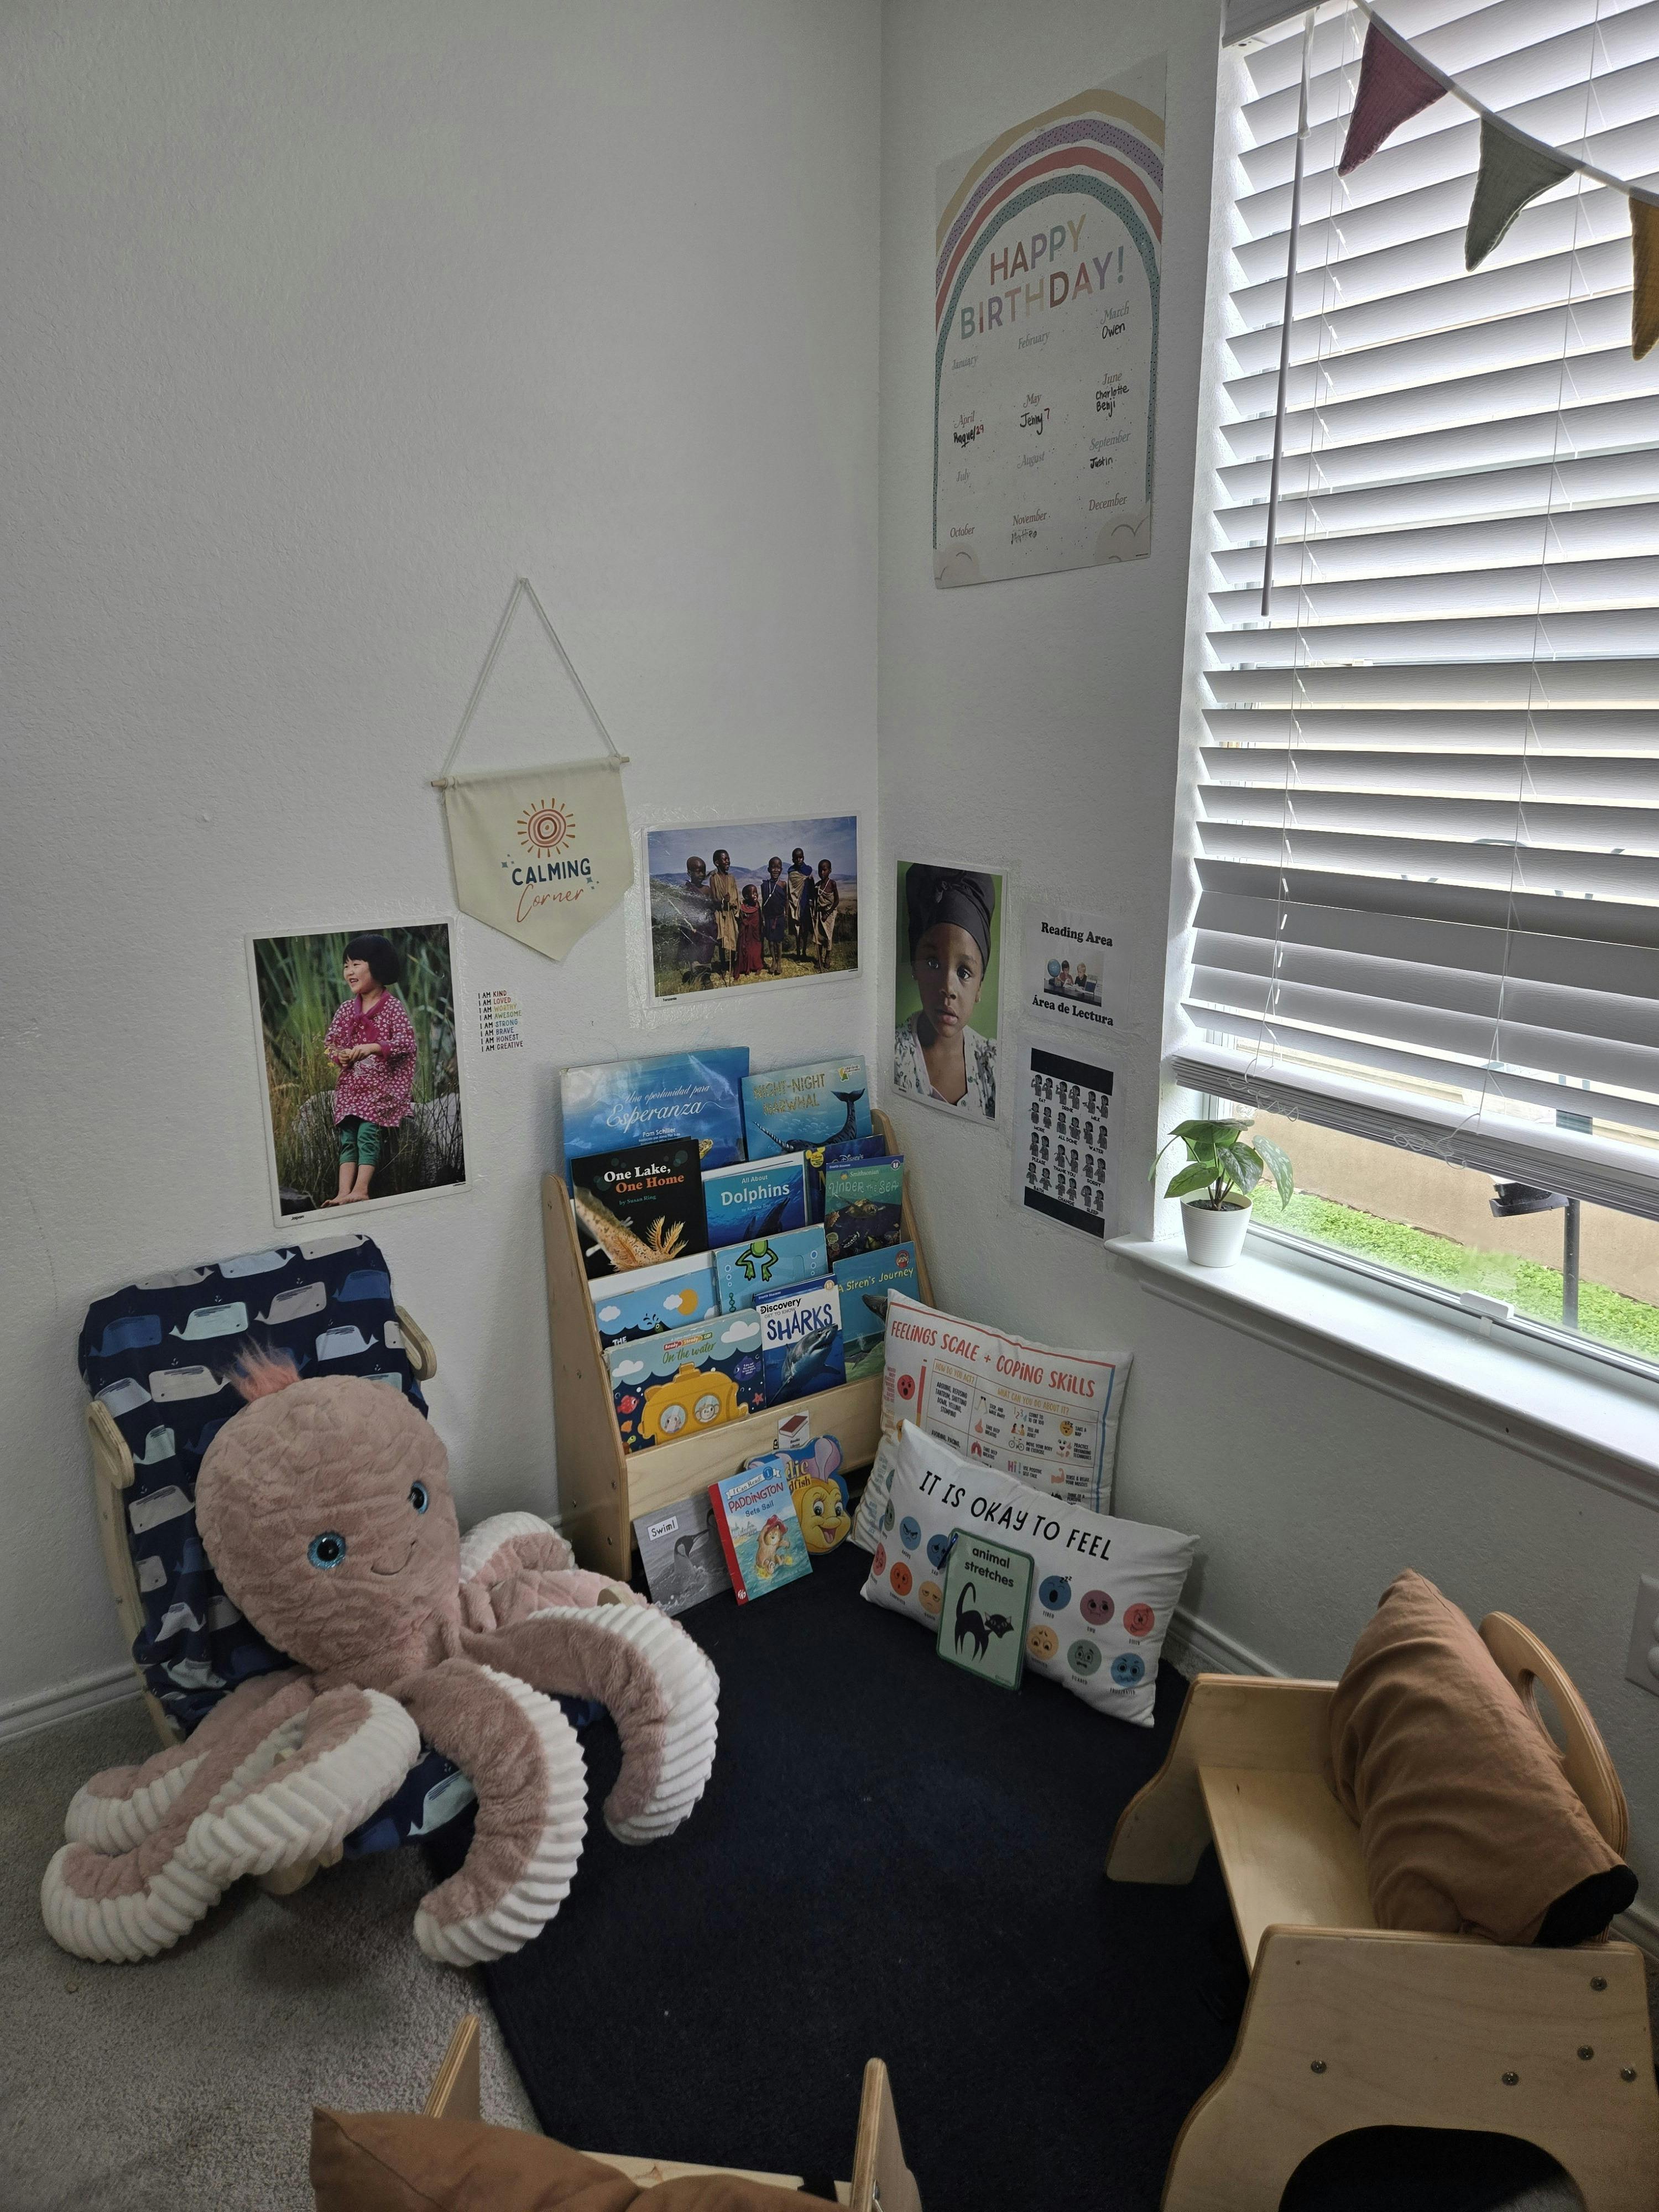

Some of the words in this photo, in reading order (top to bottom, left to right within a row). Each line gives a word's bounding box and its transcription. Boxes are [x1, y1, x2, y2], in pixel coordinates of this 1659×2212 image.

[990, 213, 1086, 285] HAPPY
[961, 246, 1124, 340] BIRTHDAY!
[1100, 301, 1129, 325] March
[1102, 323, 1125, 339] Owen
[1018, 332, 1050, 349] February
[952, 355, 978, 371] January
[1103, 373, 1122, 385] June
[1023, 393, 1042, 408] May
[1095, 385, 1129, 400] Charlotte
[1096, 398, 1115, 418] Benji
[954, 410, 975, 428] April
[1020, 413, 1043, 435] Jenny
[1089, 431, 1130, 451] September
[1017, 451, 1045, 468] August
[956, 469, 971, 482] July
[1089, 492, 1128, 512] December
[1013, 509, 1047, 526] November
[950, 523, 975, 538] October
[512, 858, 591, 886] CALMING
[517, 883, 584, 923] Corner
[1041, 922, 1084, 943] Reading
[1086, 931, 1113, 947] Area
[494, 1003, 517, 1012] WORTHY
[494, 1010, 522, 1019] AWESOME
[1032, 994, 1055, 1010] Área
[1057, 1003, 1070, 1014] de
[1072, 1005, 1114, 1026] Lectura
[495, 1019, 518, 1027] STRONG
[495, 1027, 514, 1035] BRAVE
[496, 1034, 519, 1042] HONEST
[625, 1091, 642, 1103] Una
[645, 1084, 692, 1104] oportunidad
[690, 1086, 710, 1098] para
[606, 1101, 702, 1134] Esperanza
[1066, 1137, 1078, 1145] DONE
[1089, 1145, 1103, 1155] WATER
[604, 1171, 632, 1182] One
[634, 1163, 671, 1177] Lake,
[615, 1182, 643, 1193] One
[646, 1175, 685, 1188] Home
[721, 1184, 790, 1206] Dolphins
[846, 1276, 875, 1291] Siren's
[879, 1267, 914, 1282] Journey
[760, 1298, 801, 1314] Discovery
[767, 1304, 833, 1340] SHARKS
[612, 1336, 627, 1345] THE
[940, 1333, 980, 1361] SCALE
[662, 1352, 675, 1364] On
[676, 1347, 690, 1360] the
[691, 1342, 717, 1355] water
[935, 1363, 946, 1372] HOW
[946, 1366, 953, 1375] DO
[954, 1369, 962, 1379] YOU
[997, 1387, 1010, 1398] WHAT
[1011, 1393, 1021, 1402] CAN
[1023, 1396, 1033, 1406] YOU
[1034, 1399, 1042, 1408] DO
[1043, 1401, 1060, 1413] ABOUT
[1061, 1406, 1070, 1416] IT?
[747, 1475, 763, 1485] Read!
[789, 1477, 811, 1493] dfish
[728, 1482, 784, 1514] PADDINGTON
[745, 1507, 760, 1517] Sets
[761, 1500, 774, 1511] Sail
[919, 1470, 942, 1495] IT
[942, 1484, 966, 1507] IS
[971, 1497, 1029, 1531] OKAY
[1032, 1515, 1061, 1541] TO
[1066, 1529, 1112, 1561] FEEL
[651, 1520, 675, 1537] Swim!
[972, 1547, 1010, 1569] animal
[964, 1561, 1014, 1588] stretches
